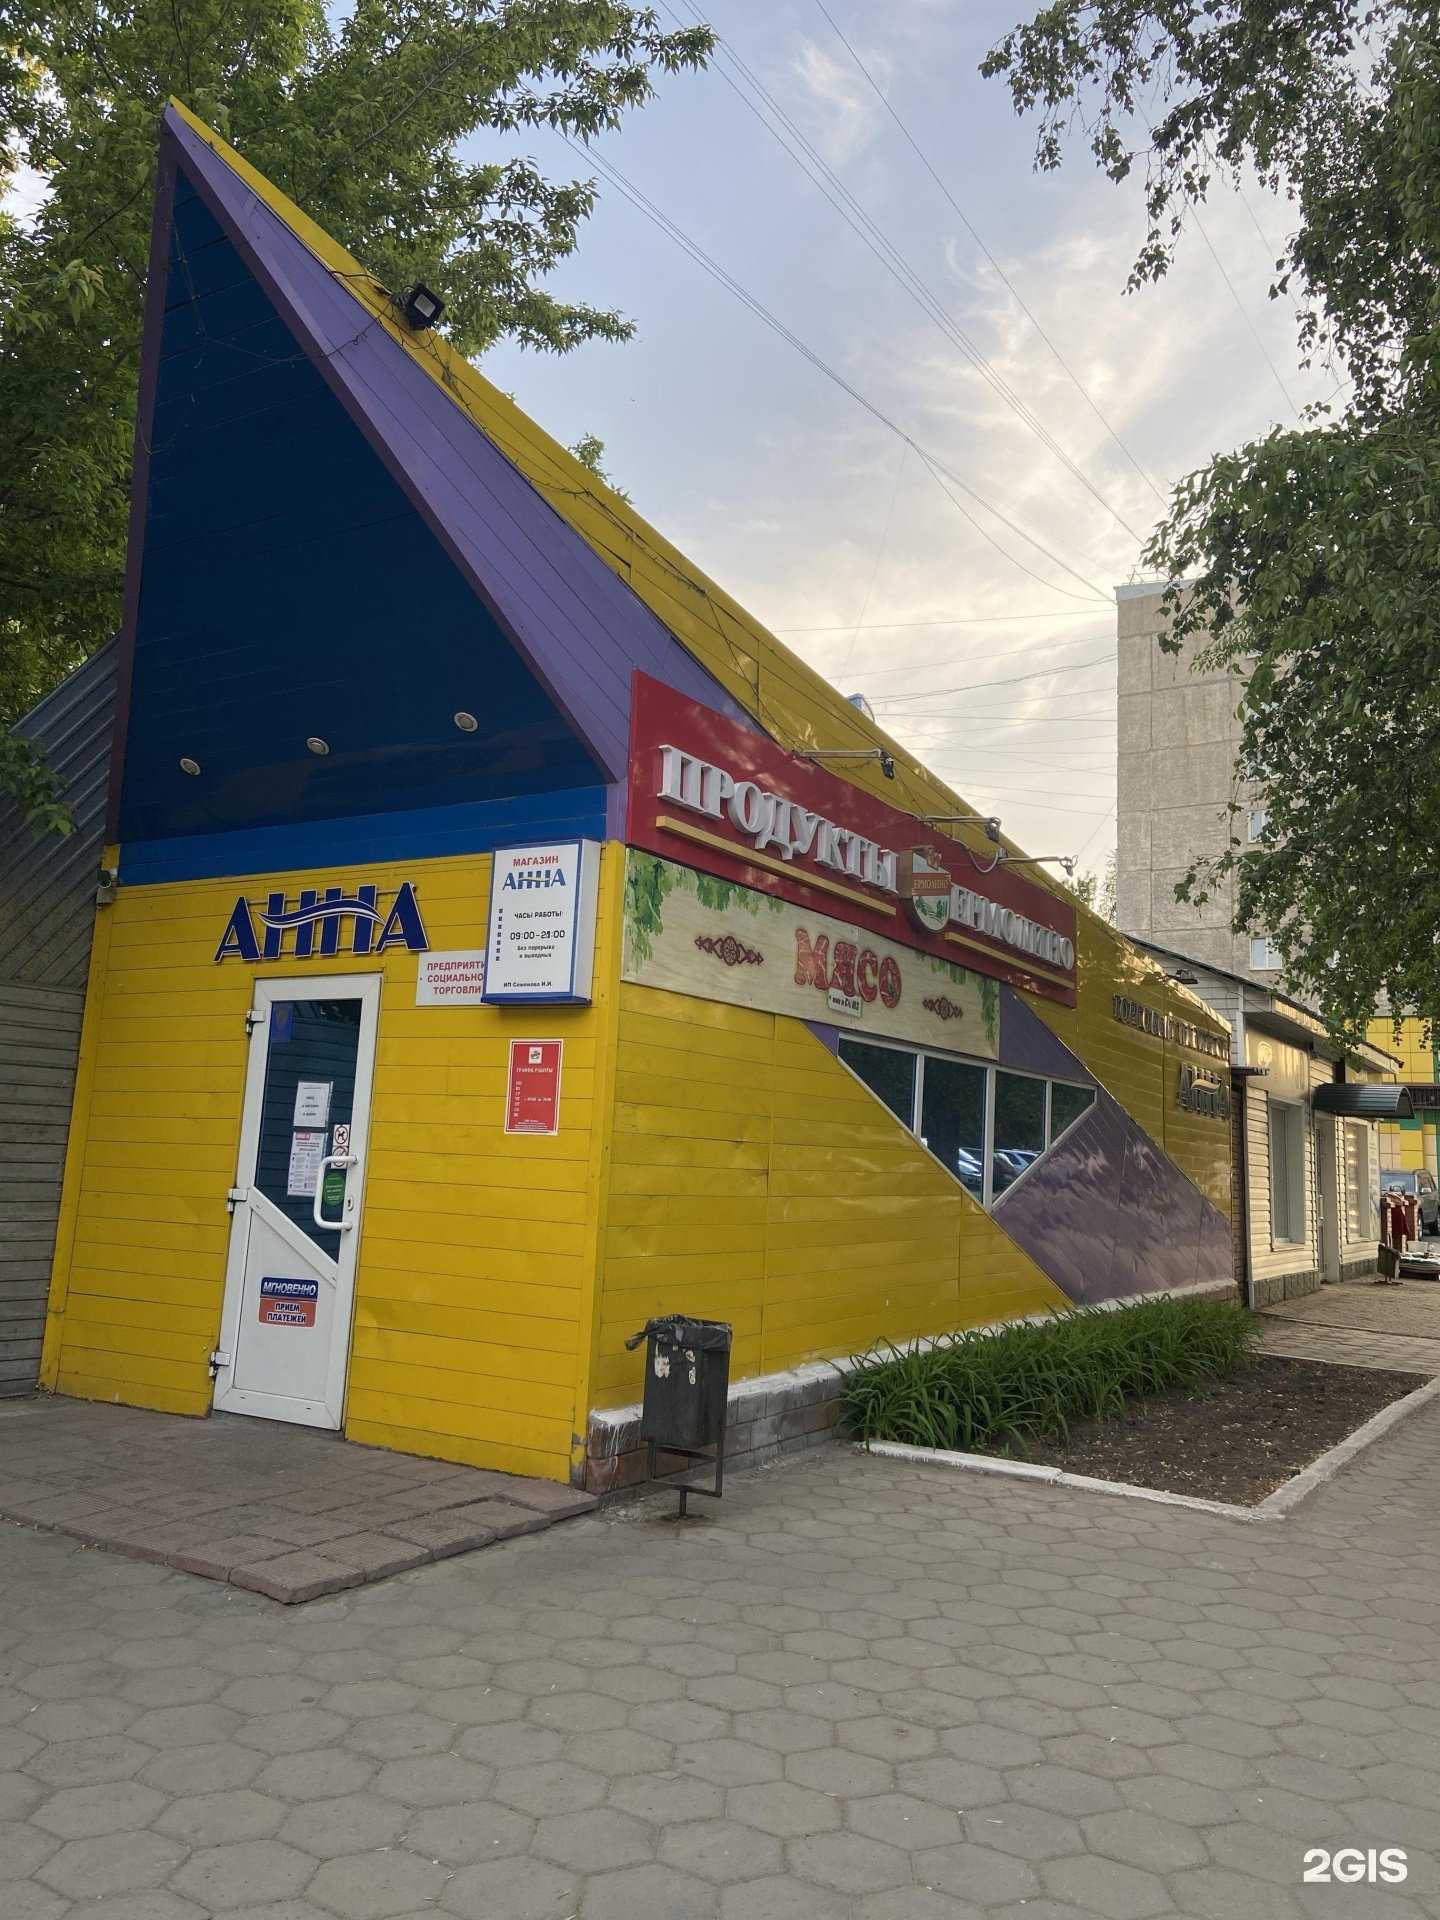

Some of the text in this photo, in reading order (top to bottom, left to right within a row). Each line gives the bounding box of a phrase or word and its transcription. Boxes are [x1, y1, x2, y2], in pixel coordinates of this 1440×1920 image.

[656, 743, 900, 895] ПРОДУКТЫ
[513, 855, 559, 867] МАГАЗИН
[502, 868, 567, 891] АННА
[212, 880, 430, 963] АННА
[794, 928, 902, 1008] МЯСО
[433, 986, 481, 995] ТОРГОВЛИ
[263, 1282, 316, 1295] МГНОВЕННО
